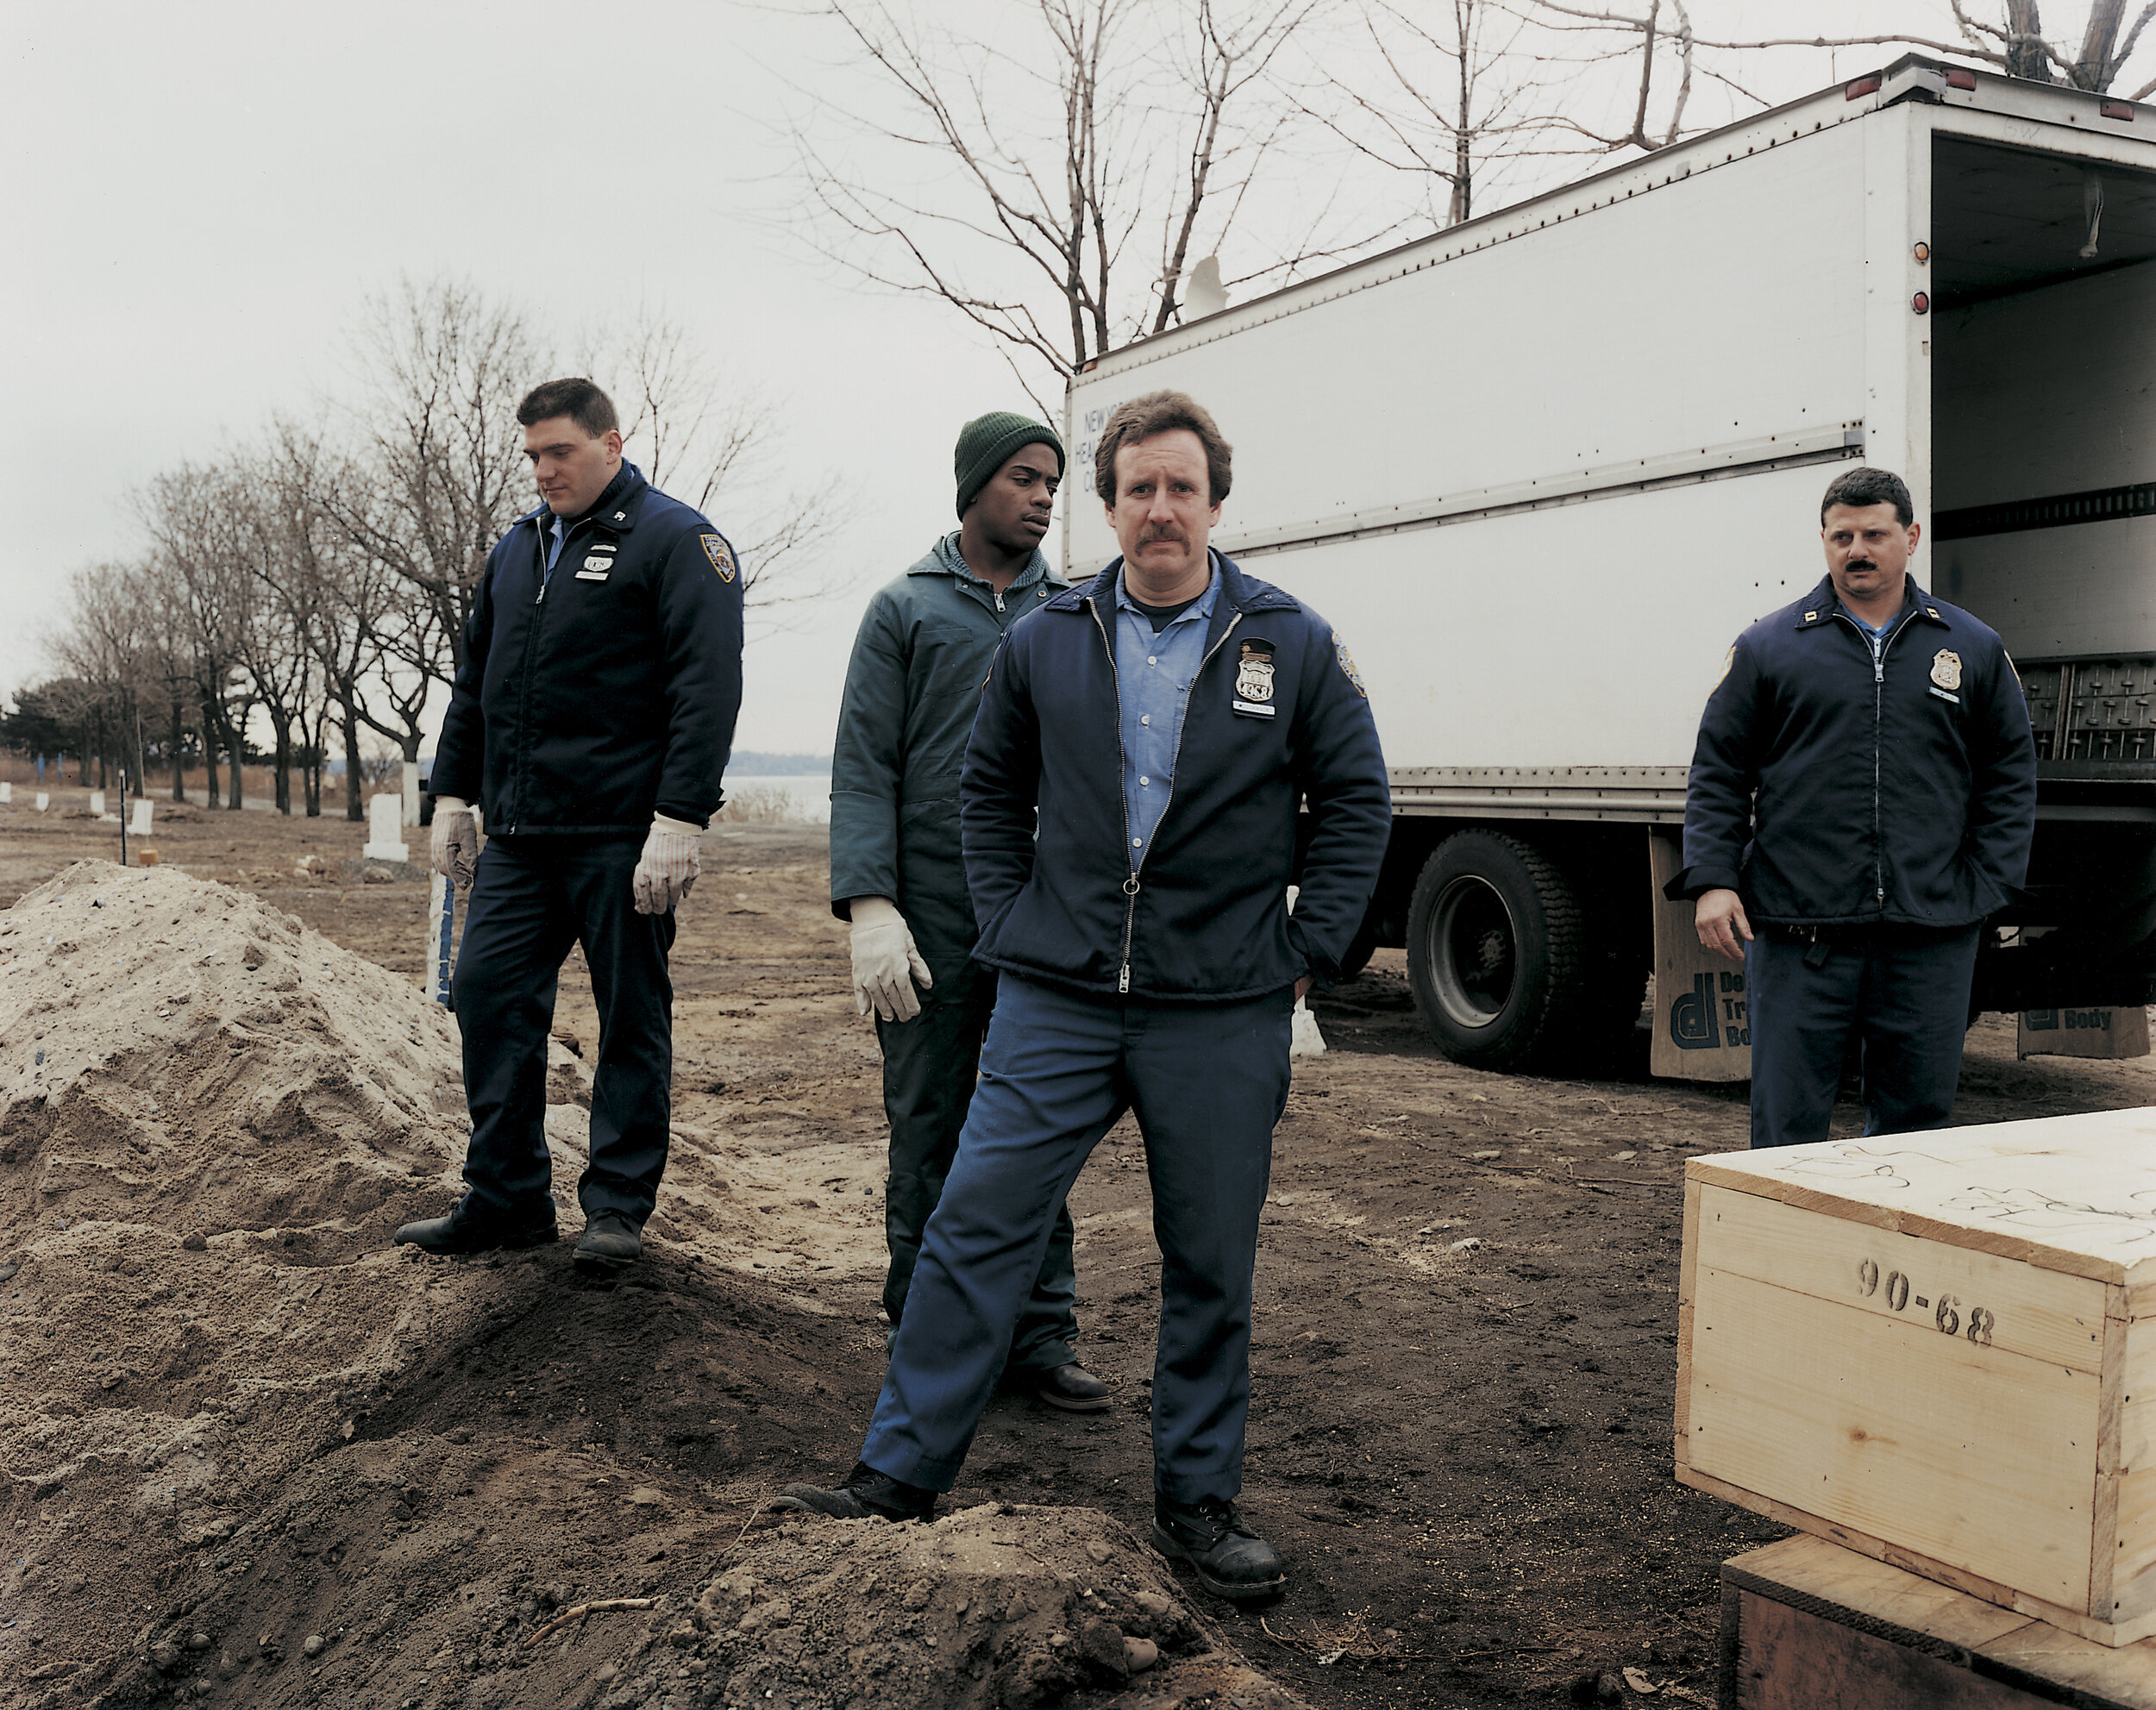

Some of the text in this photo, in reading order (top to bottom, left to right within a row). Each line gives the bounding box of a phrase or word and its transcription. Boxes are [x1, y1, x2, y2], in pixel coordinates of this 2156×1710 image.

[1084, 407, 1105, 435] NEW
[2065, 1008, 2111, 1031] Body
[1858, 1257, 1995, 1349] 90-68
